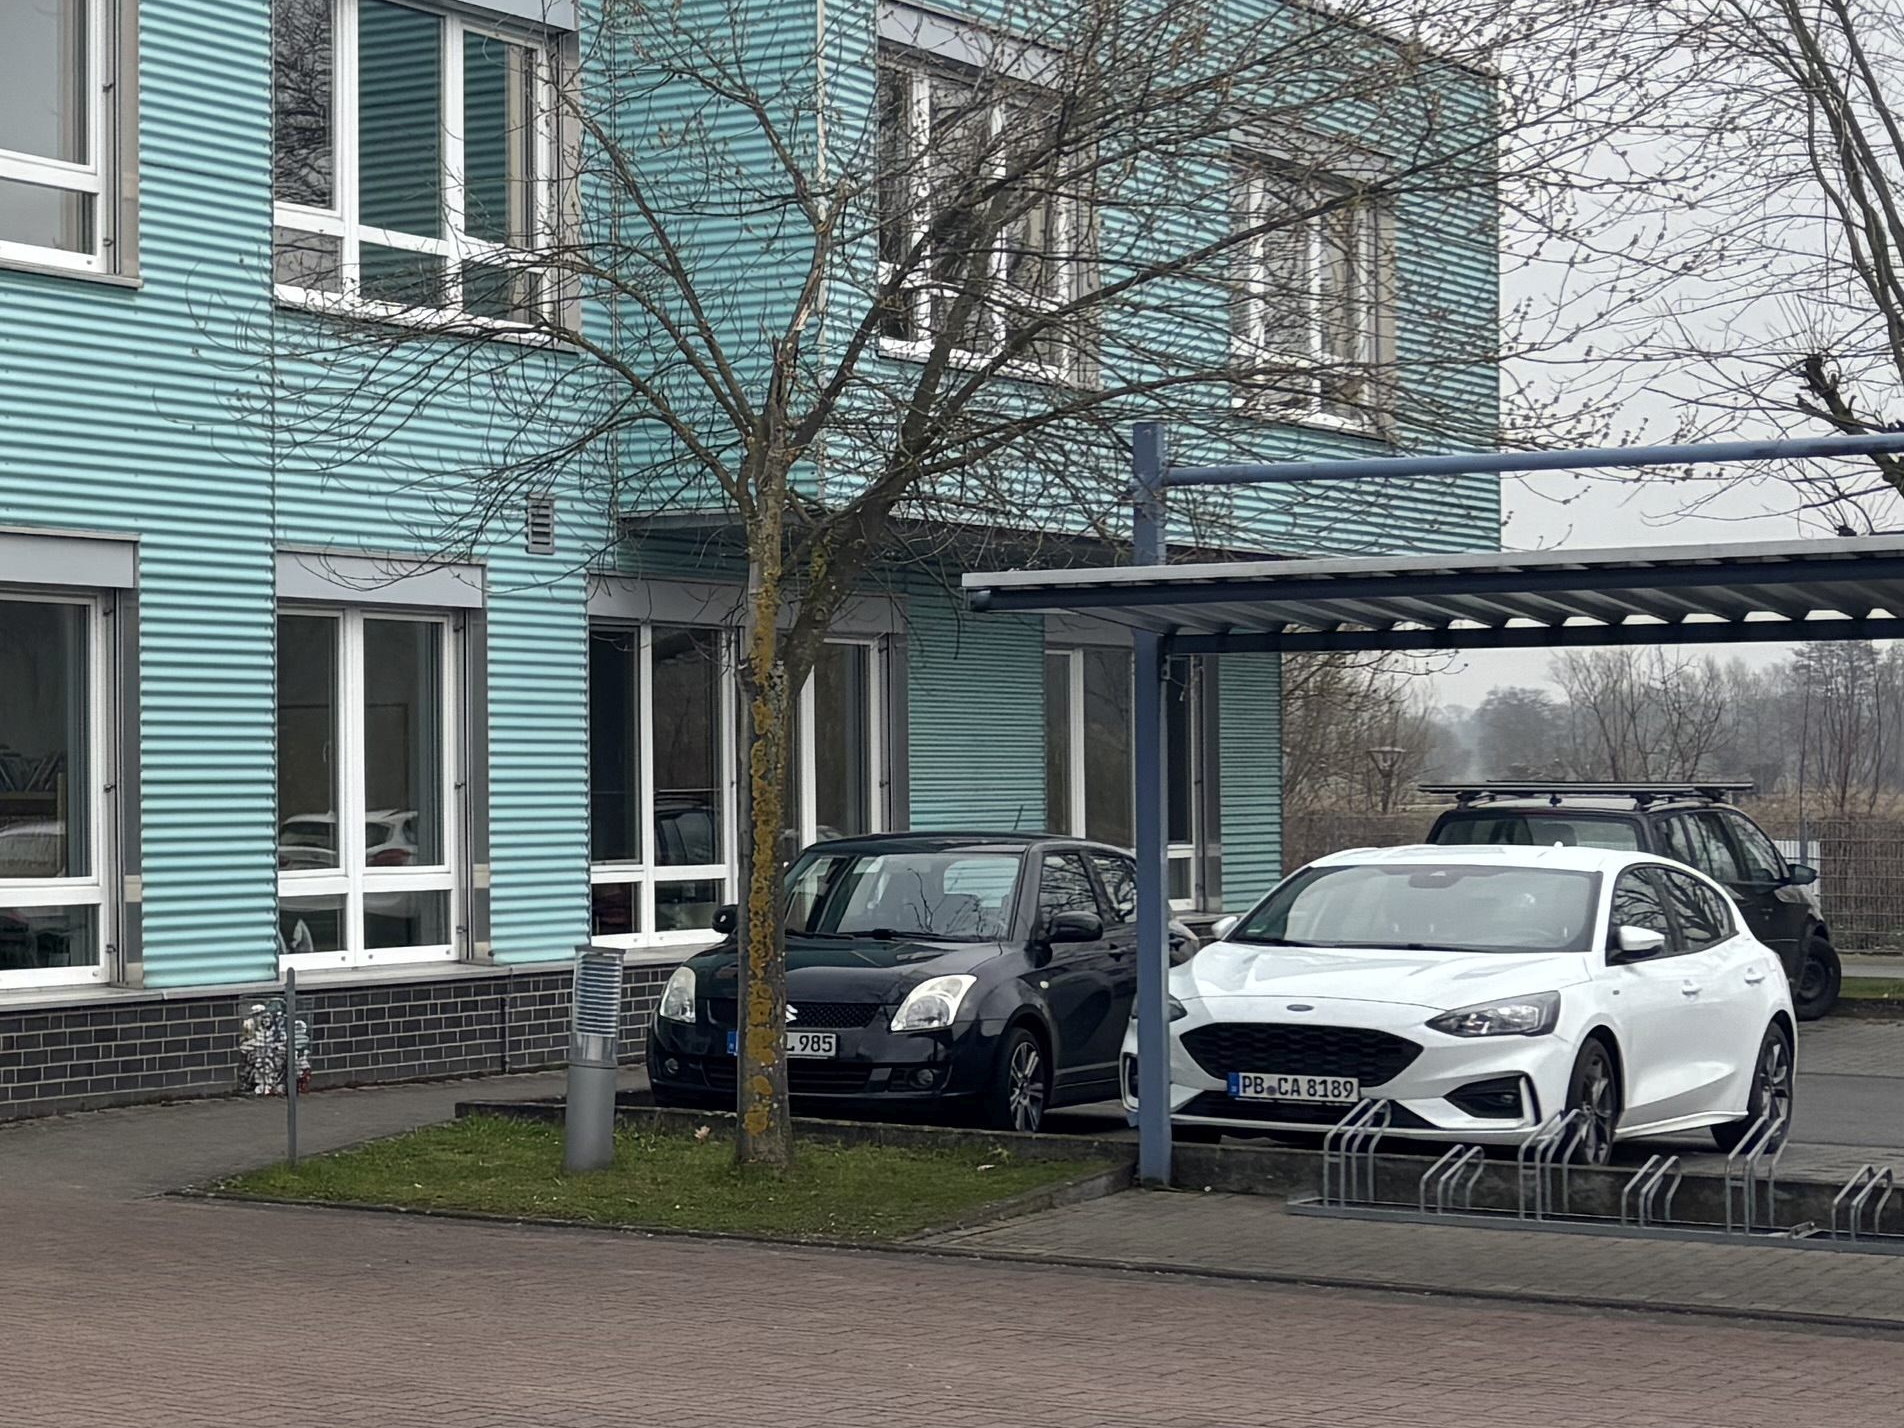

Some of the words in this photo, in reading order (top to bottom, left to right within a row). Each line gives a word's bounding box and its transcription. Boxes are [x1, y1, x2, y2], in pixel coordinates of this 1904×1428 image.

[799, 1035, 834, 1052] 985
[1242, 1076, 1265, 1094] PB
[1277, 1077, 1302, 1096] CA
[1307, 1079, 1354, 1098] 8189
